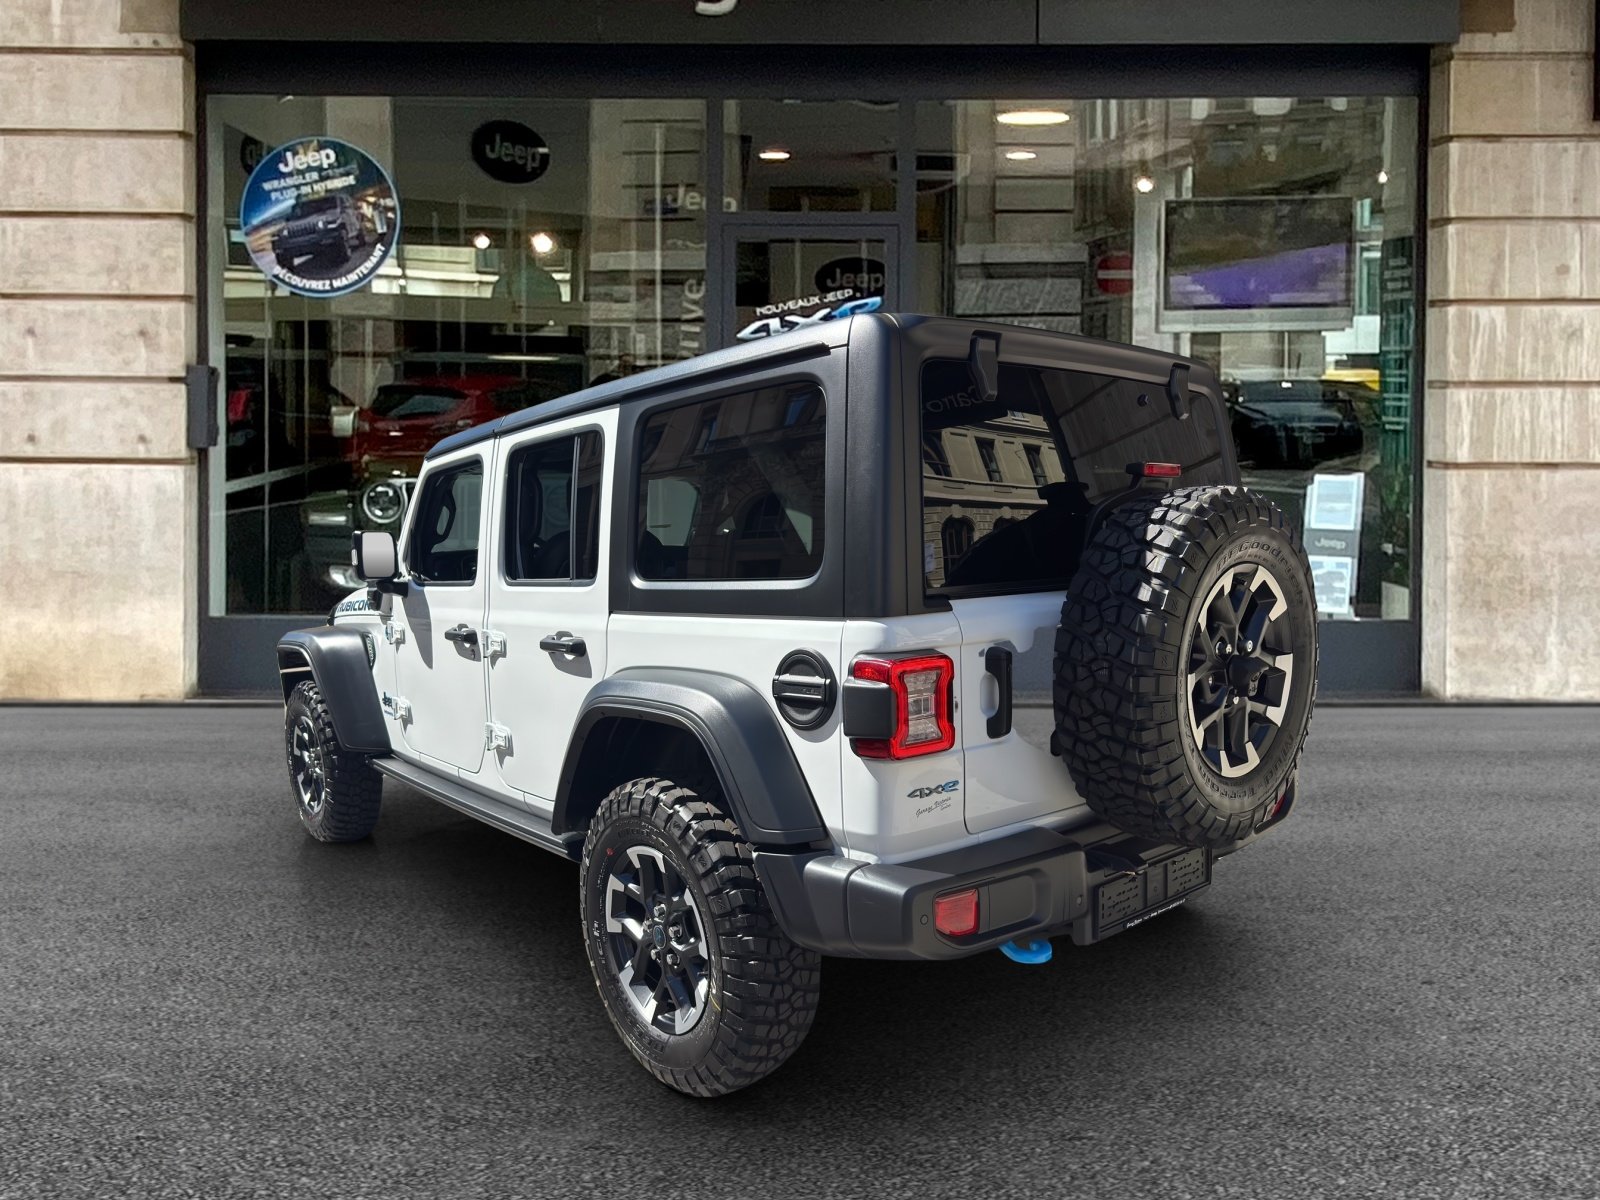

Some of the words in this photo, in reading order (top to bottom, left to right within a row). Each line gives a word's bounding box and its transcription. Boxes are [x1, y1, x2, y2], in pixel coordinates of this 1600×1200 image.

[278, 148, 336, 173] Jeep
[485, 133, 541, 172] Jeep
[262, 171, 320, 191] WRANGLER
[271, 184, 312, 201] PLUG-IN
[667, 184, 737, 213] Jep
[273, 265, 332, 290] DÉCOUVREZ
[332, 242, 386, 289] MAINTENANT
[826, 267, 883, 292] Jeep
[755, 295, 821, 316] NOUVEAUX
[823, 288, 854, 303] JEEP
